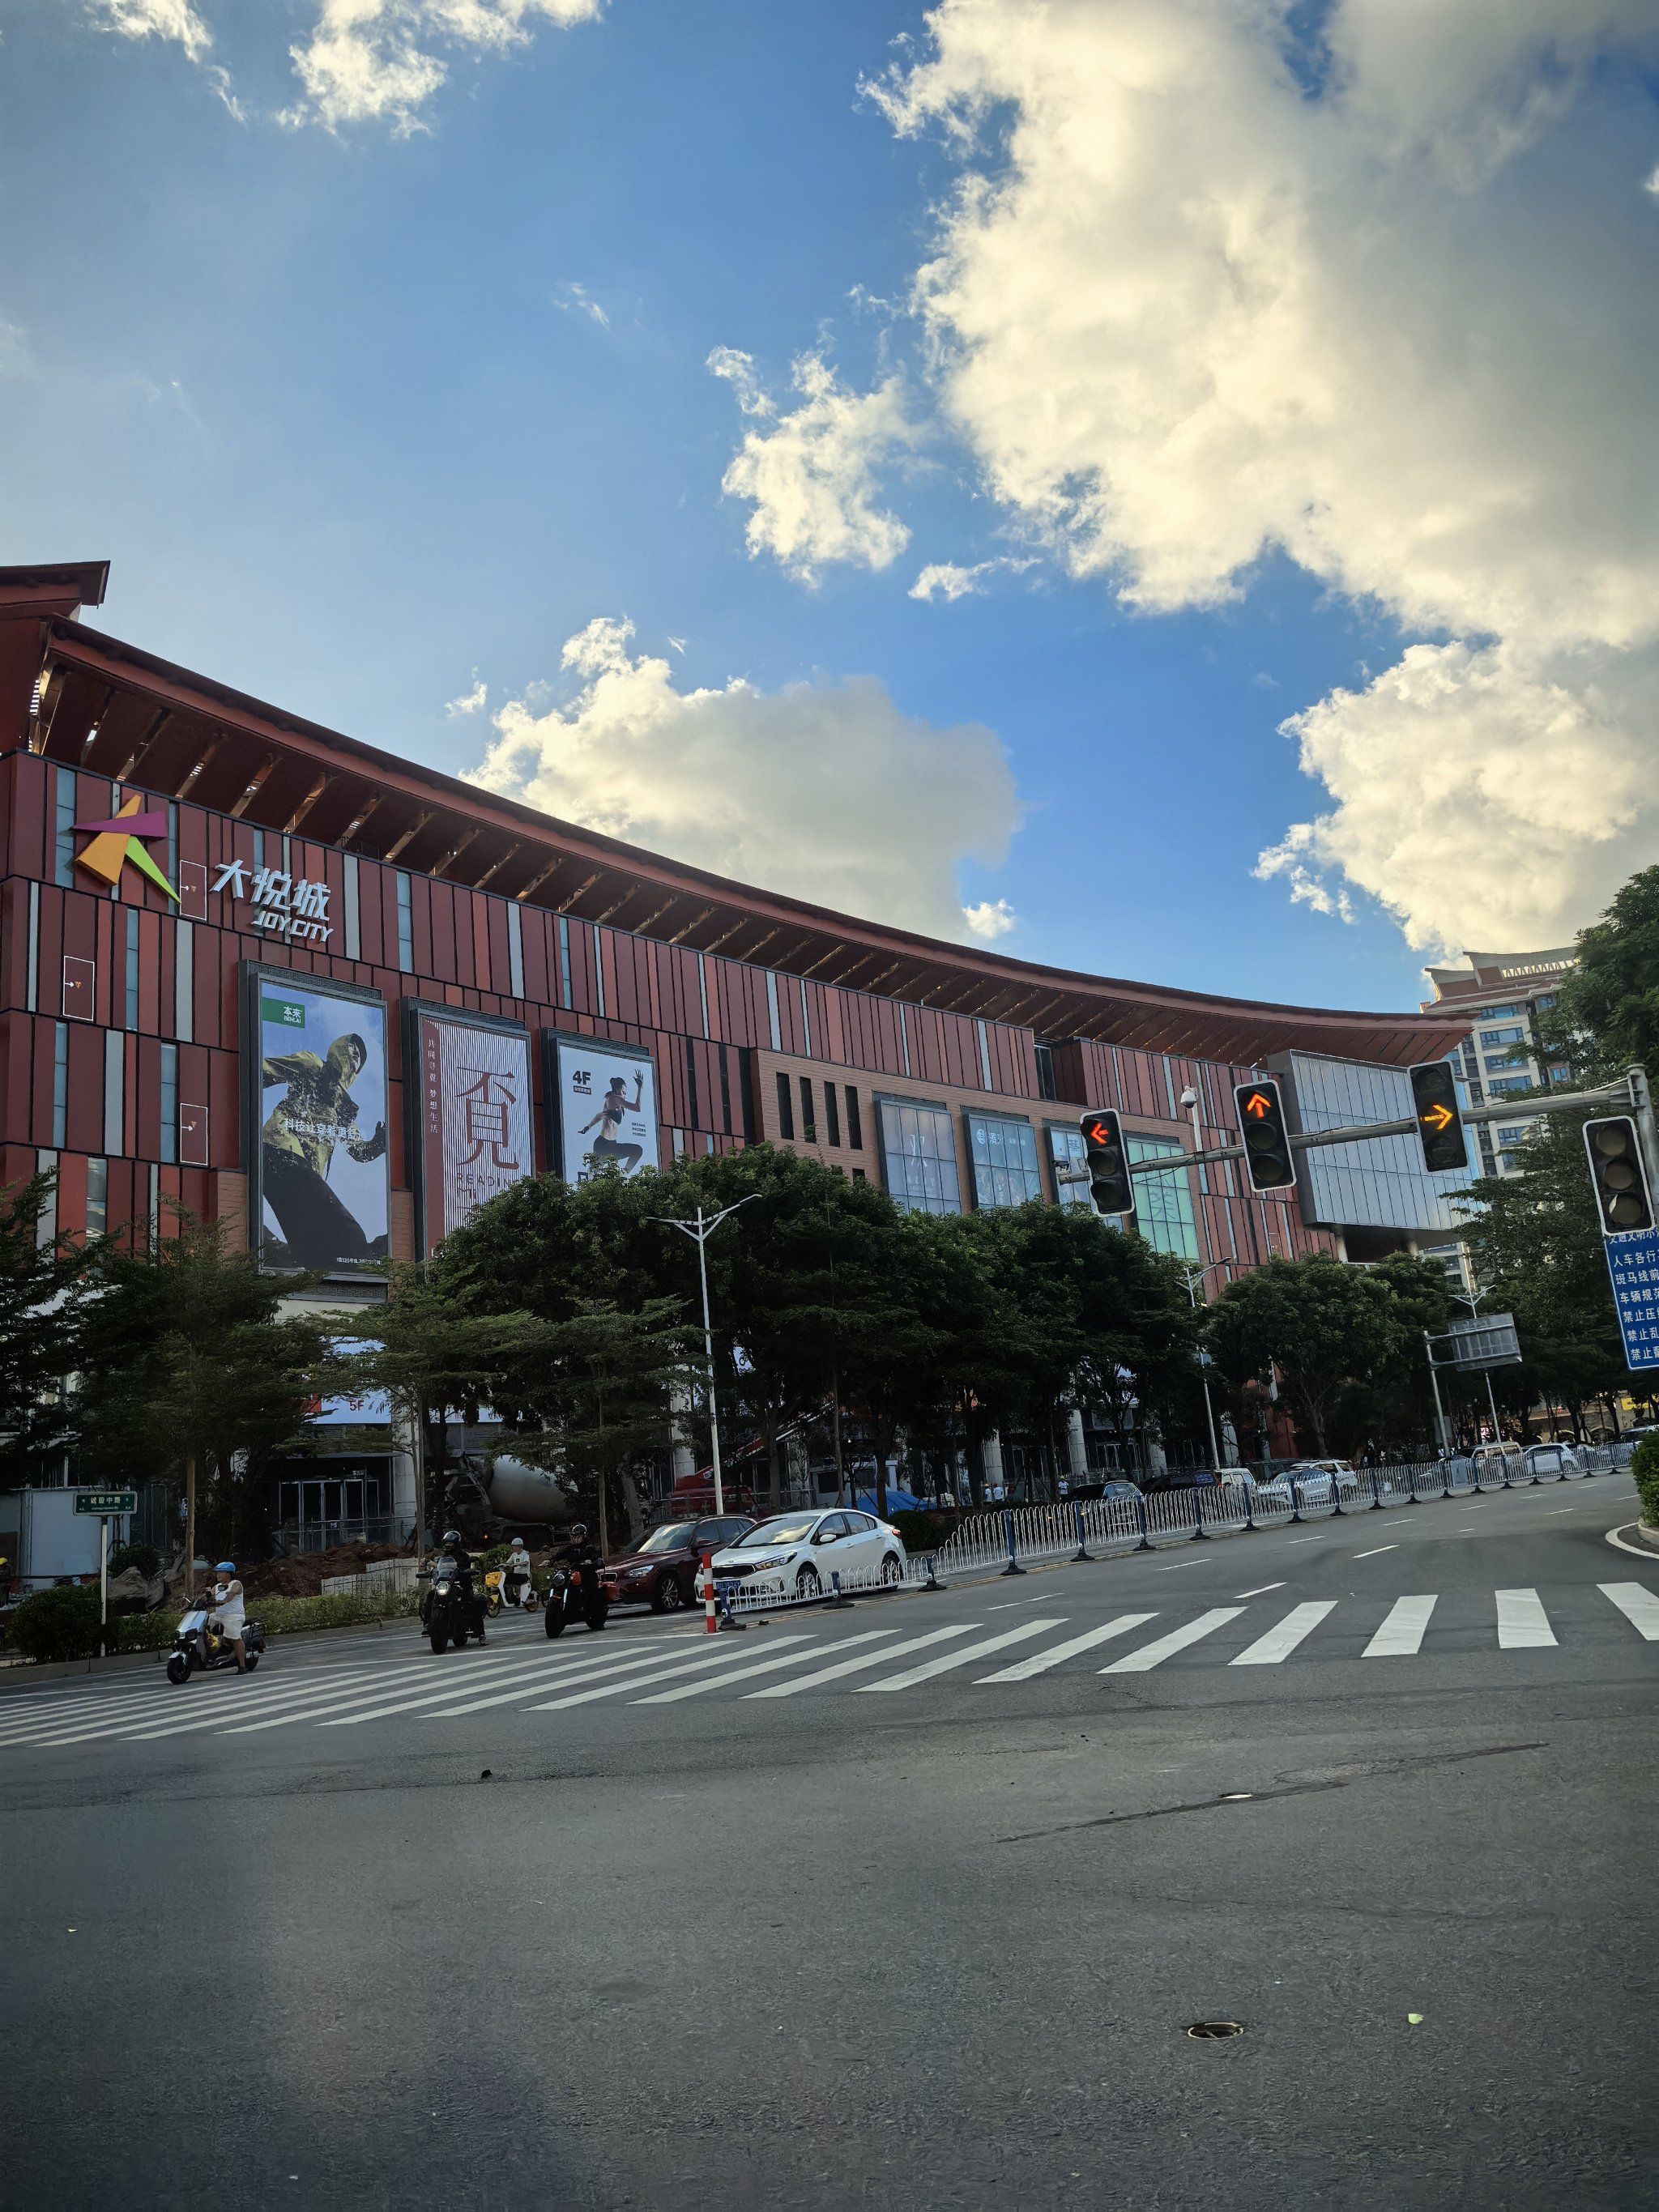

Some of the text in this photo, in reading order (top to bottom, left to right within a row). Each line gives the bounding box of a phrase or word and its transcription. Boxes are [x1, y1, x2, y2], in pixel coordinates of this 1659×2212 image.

[209, 859, 331, 921] 大悦城
[250, 910, 334, 942] JOY CITY
[284, 1006, 302, 1018] 本来
[573, 1070, 591, 1085] 4F
[284, 1118, 368, 1142] 科技让穿着更舒
[456, 1172, 513, 1189] READIN
[1614, 1249, 1659, 1268] 人车各行
[1615, 1268, 1659, 1285] 斑马线前
[1623, 1306, 1659, 1323] 禁止压
[349, 1400, 365, 1412] 5F
